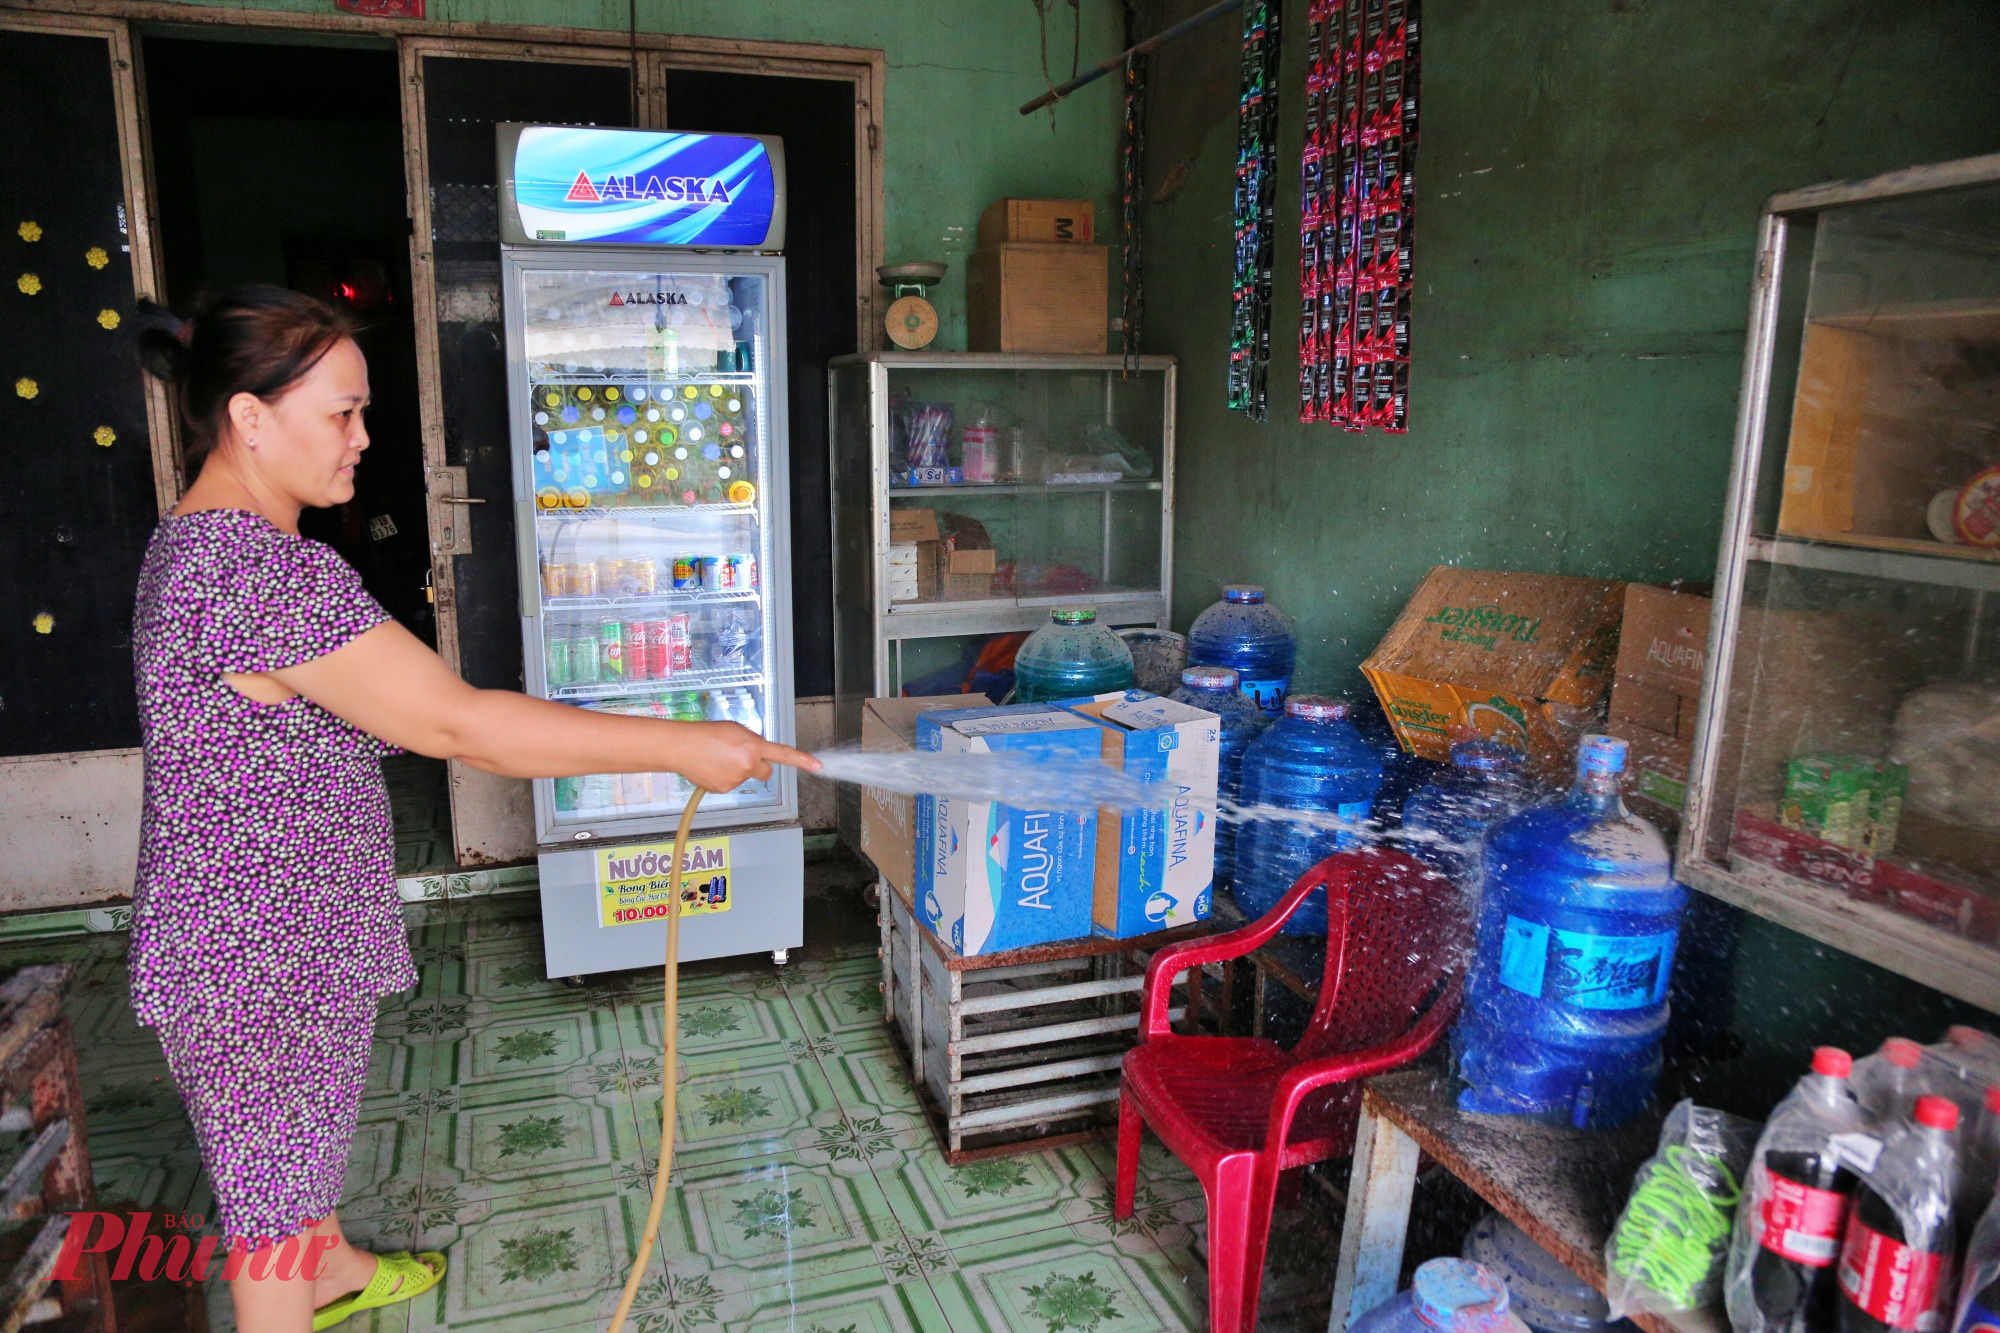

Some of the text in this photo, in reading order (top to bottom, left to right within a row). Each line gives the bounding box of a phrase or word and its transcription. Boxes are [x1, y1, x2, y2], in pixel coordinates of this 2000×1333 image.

[602, 174, 730, 203] ALASKA
[625, 292, 687, 305] ALASKA
[1424, 605, 1542, 644] Twister
[1209, 728, 1217, 743] 24
[936, 794, 949, 876] AQUAFINA
[1168, 785, 1191, 870] AQUAFINA
[609, 846, 723, 880] NƯỚC SÂM
[1017, 808, 1054, 910] AQUAFI
[1806, 861, 1874, 886] STING
[618, 882, 646, 895] Rong
